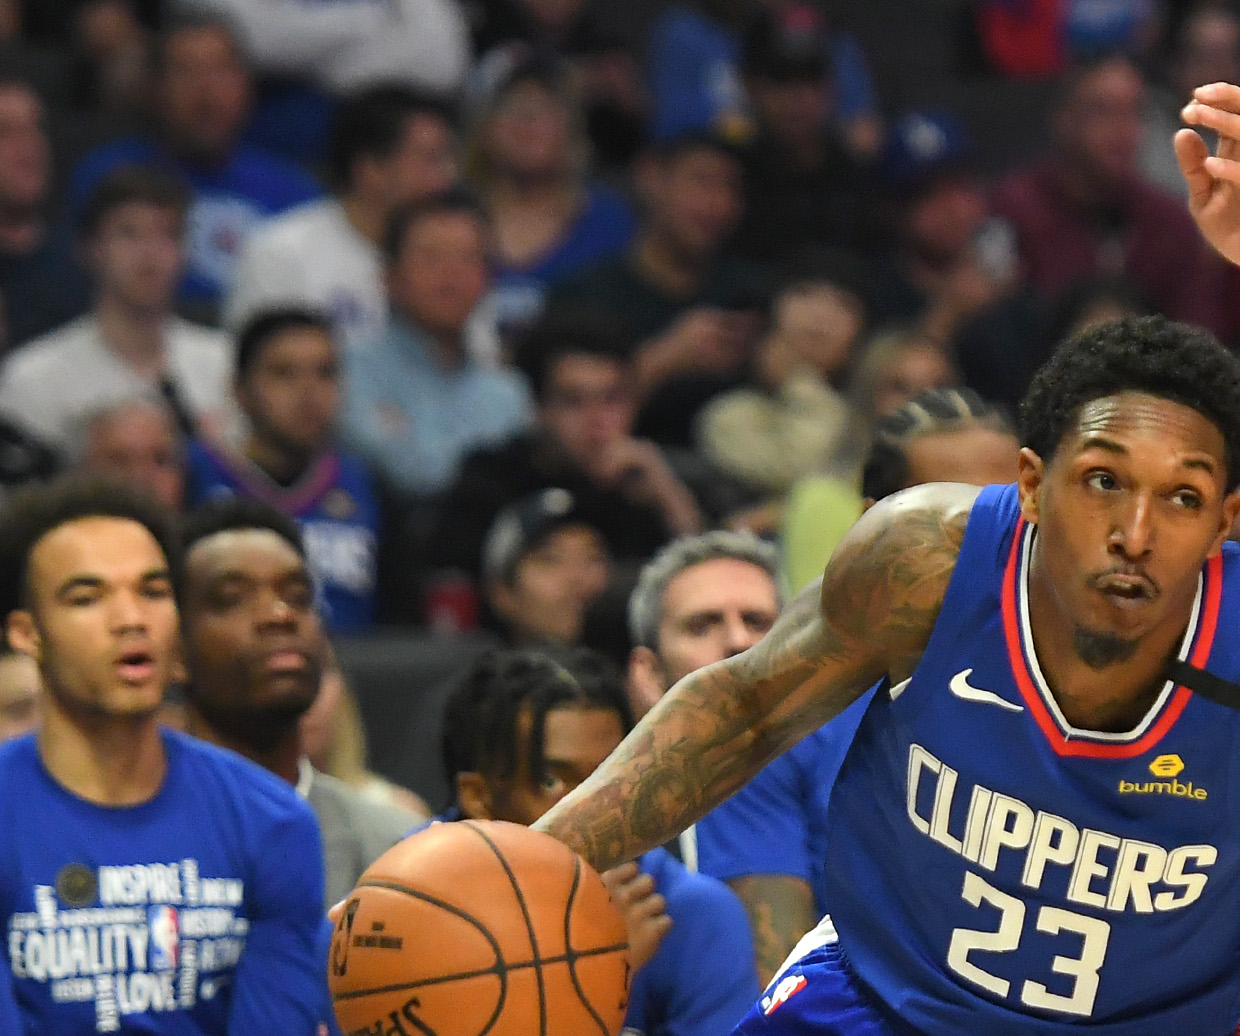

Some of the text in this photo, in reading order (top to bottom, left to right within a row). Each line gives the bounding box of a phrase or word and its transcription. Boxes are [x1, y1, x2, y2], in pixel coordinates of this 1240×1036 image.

[1119, 780, 1208, 800] bumble
[907, 743, 1218, 913] CLIPPERS
[8, 923, 149, 983] EQUALITY
[947, 870, 1111, 1017] 23
[116, 969, 177, 1014] LOVE
